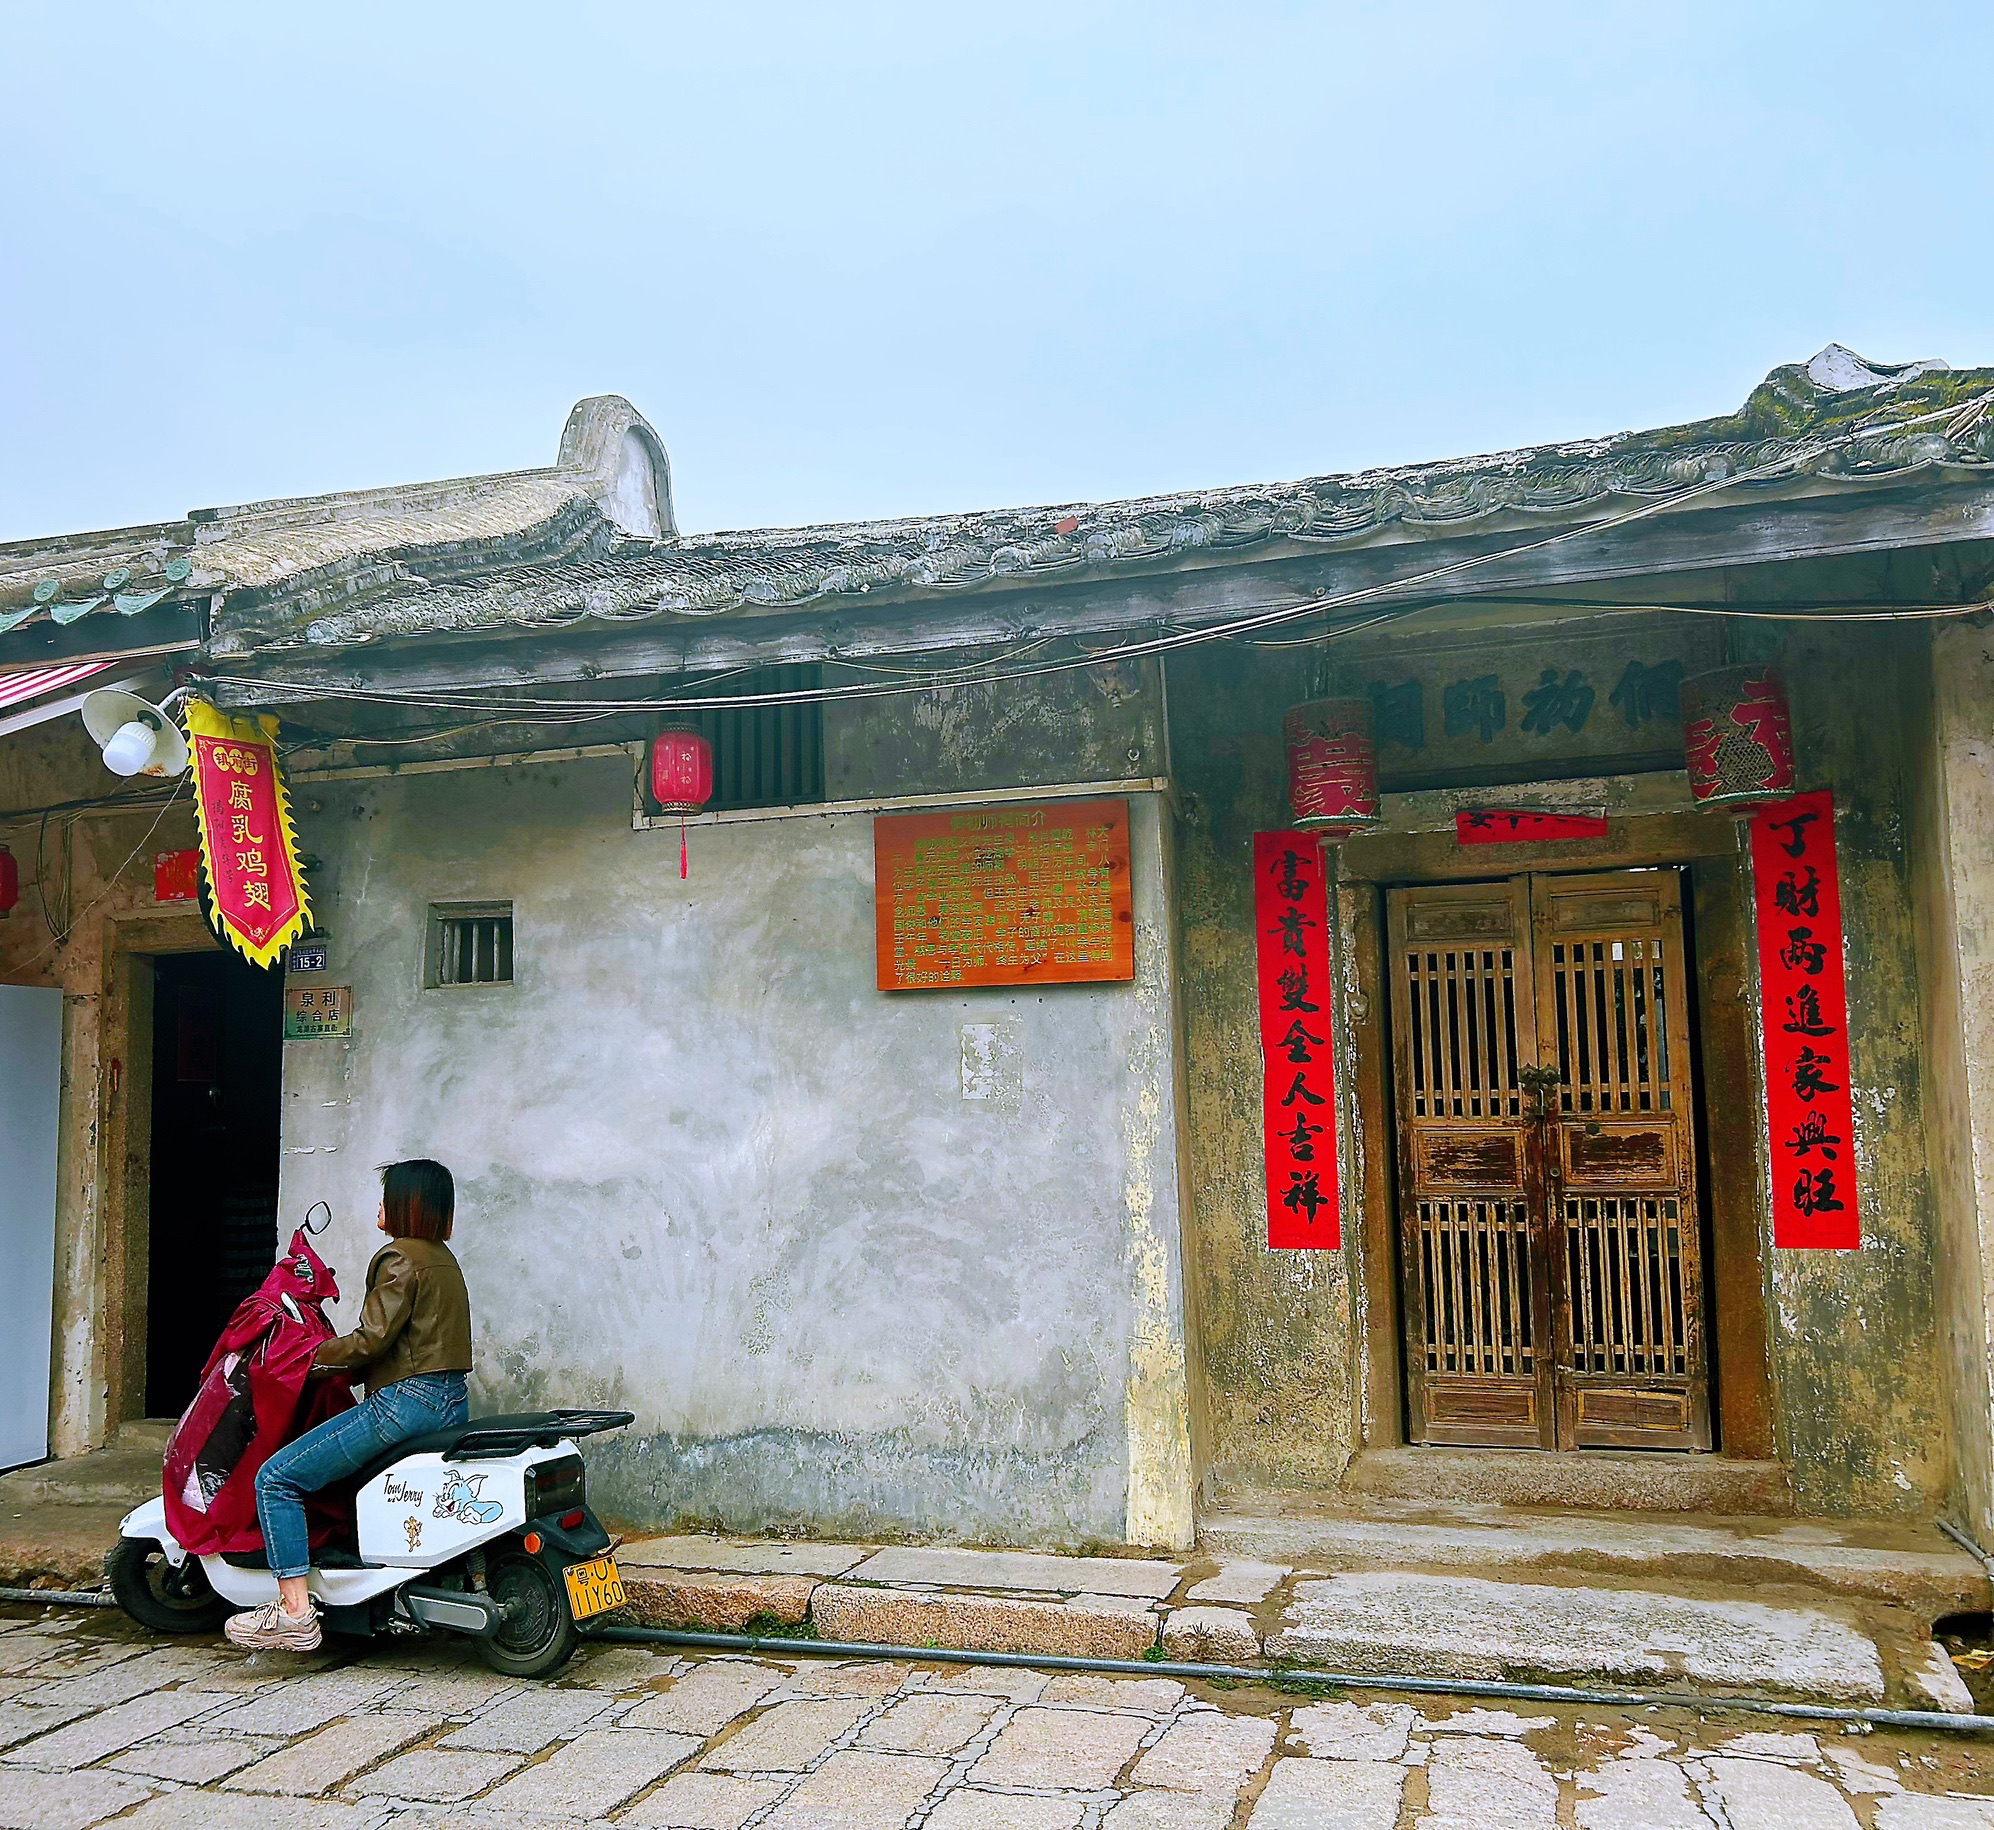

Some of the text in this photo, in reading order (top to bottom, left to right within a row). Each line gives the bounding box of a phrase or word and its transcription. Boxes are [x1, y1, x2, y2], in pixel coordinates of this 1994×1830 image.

[228, 780, 272, 911] 腐乳鸡翅
[299, 955, 323, 969] 15-2
[300, 990, 336, 1007] 泉利
[296, 1009, 340, 1022] 综合店
[1267, 849, 1328, 1225] 富貴雙全人吉祥
[383, 1473, 401, 1495] Tom
[394, 1480, 424, 1508] Jerry
